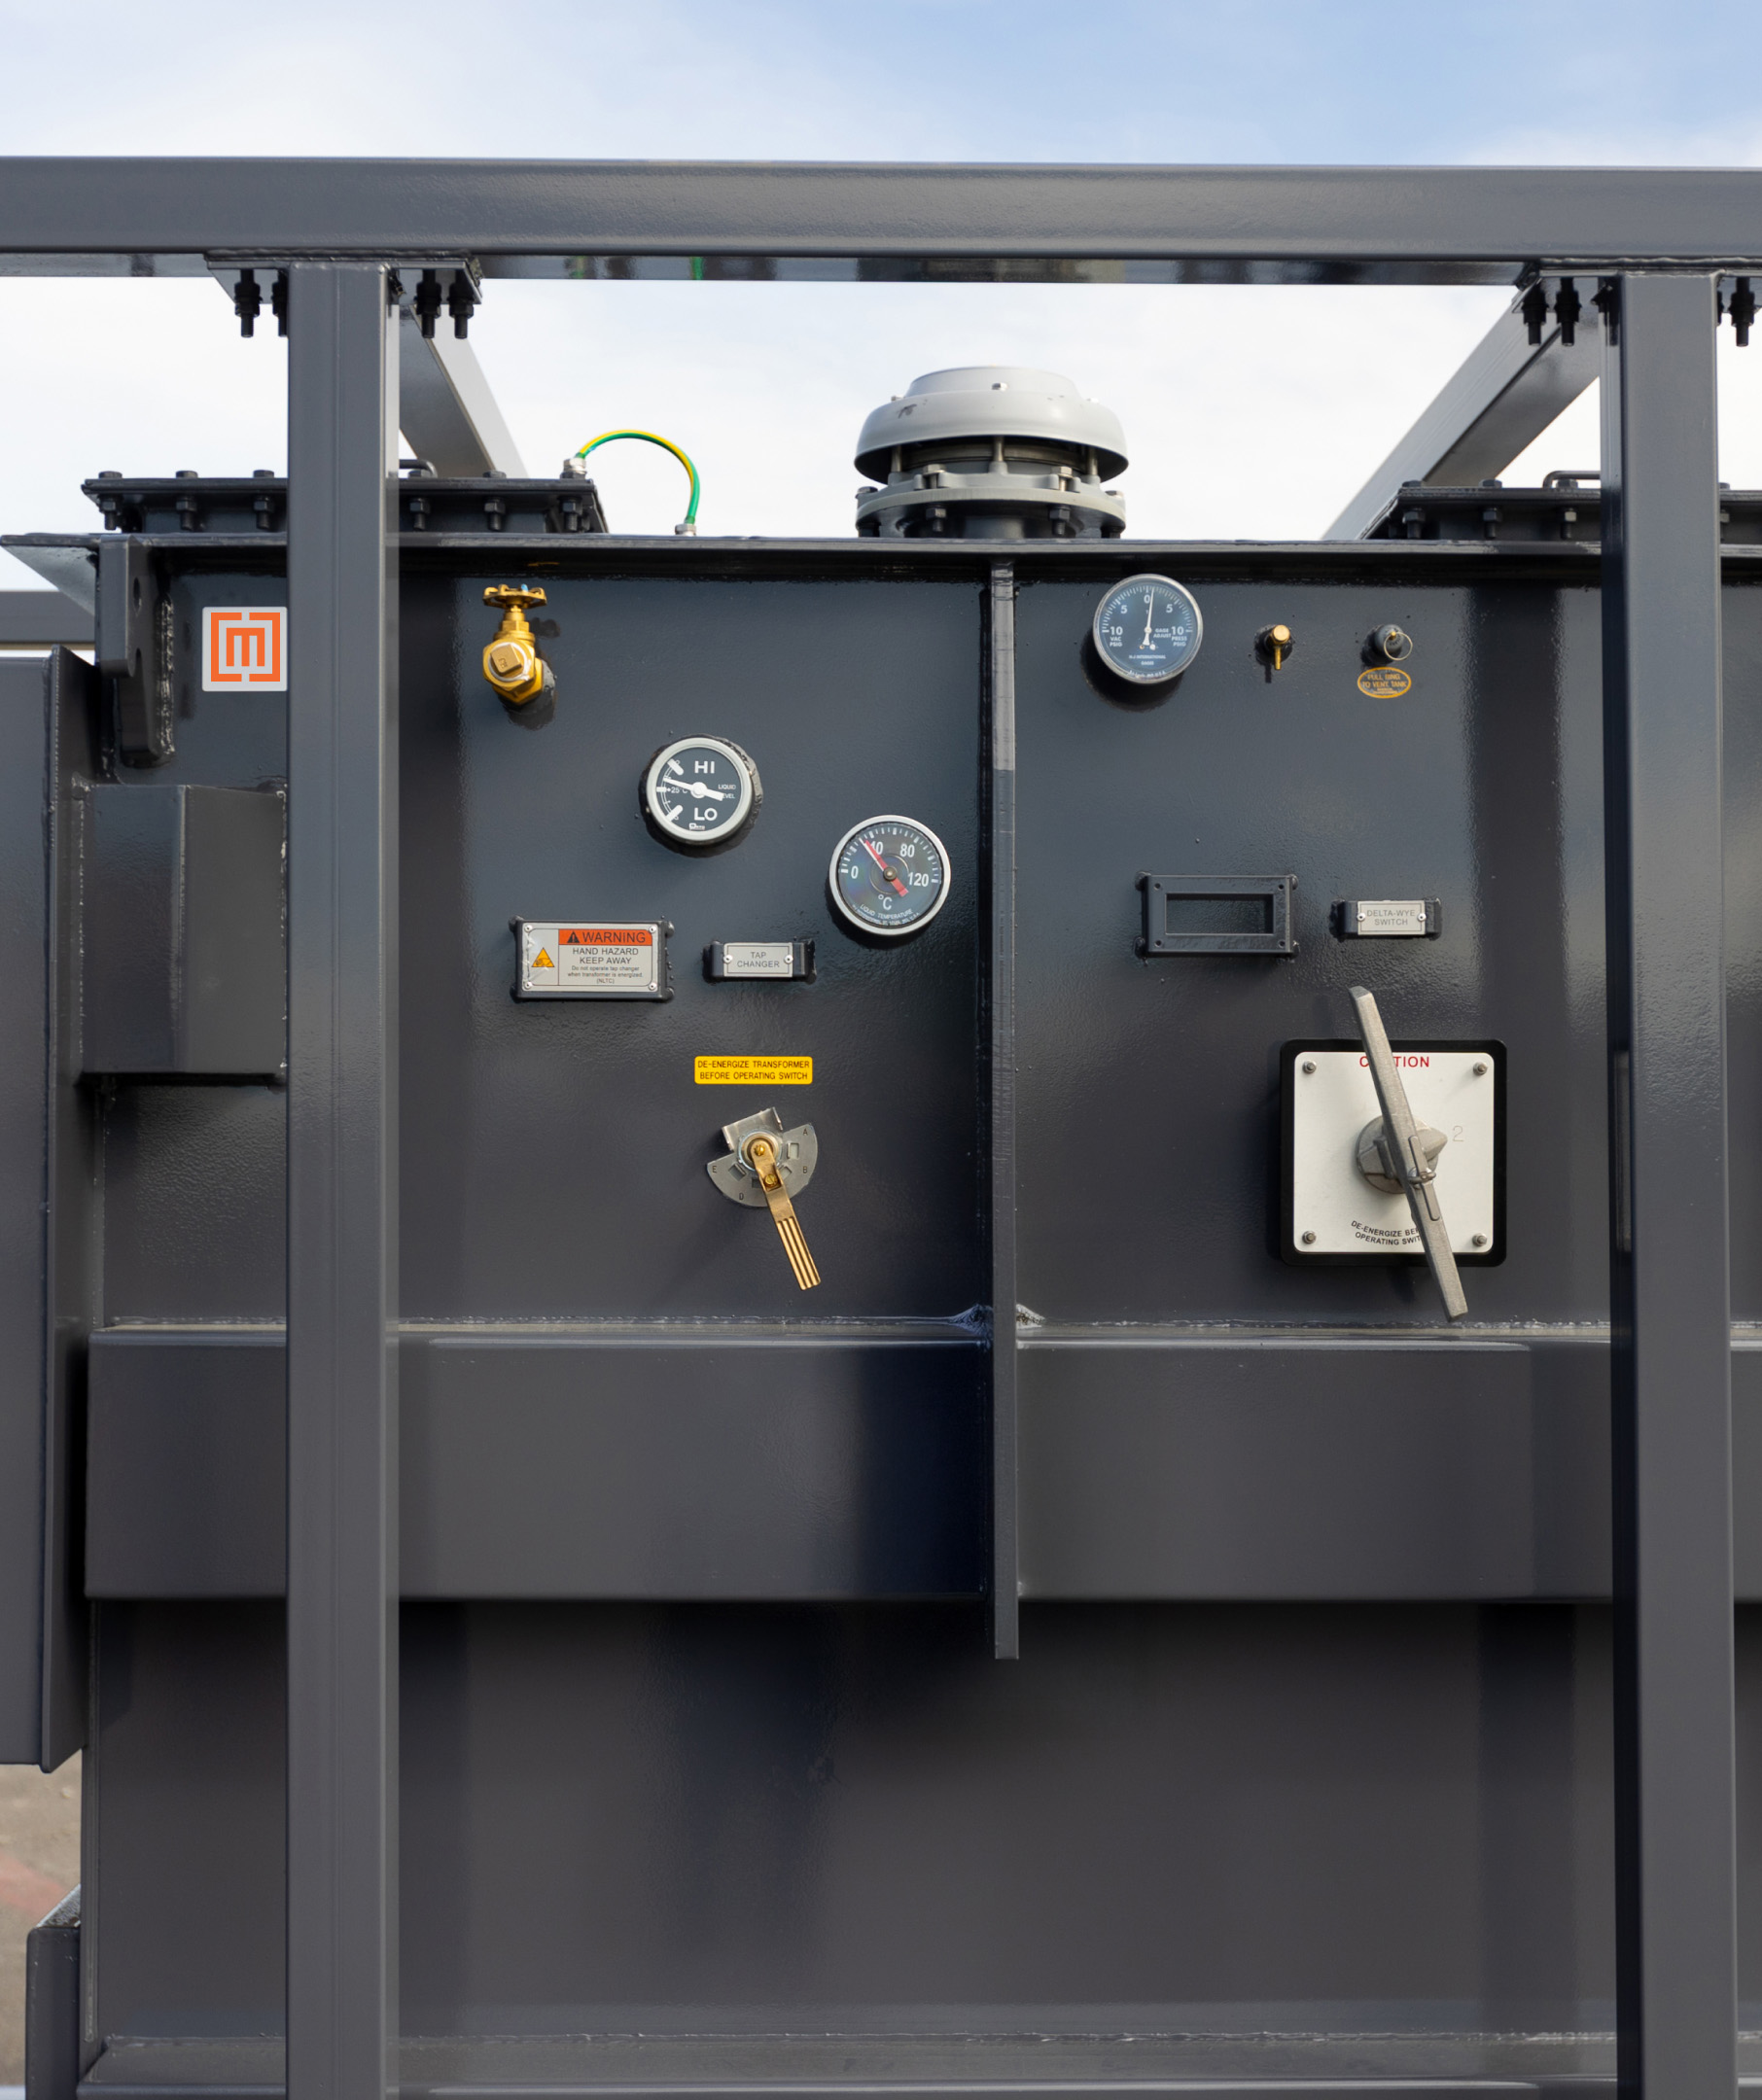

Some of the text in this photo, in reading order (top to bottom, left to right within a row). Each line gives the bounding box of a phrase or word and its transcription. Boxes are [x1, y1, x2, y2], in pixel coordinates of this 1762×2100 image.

[1144, 594, 1150, 604] 0
[1120, 605, 1128, 614] 5
[1166, 604, 1173, 613] 5
[1110, 626, 1123, 636] 10
[1172, 626, 1184, 636] 10
[694, 760, 715, 774] HI
[693, 807, 718, 822] LO
[899, 843, 915, 858] 80
[850, 865, 859, 879] 0
[907, 872, 930, 887] 120
[877, 893, 893, 911] °C
[860, 903, 876, 917] LIQUID
[877, 907, 914, 920] TEMPERATURE
[582, 931, 646, 943] WARNING
[573, 947, 639, 956] HAND HAZARD
[736, 960, 780, 968] CHANGER
[697, 1060, 810, 1068] DE-ENERGIZE TRANSFORMER
[1359, 1056, 1429, 1068] CTION
[1452, 1125, 1464, 1142] 2
[712, 1165, 718, 1173] E
[739, 1192, 744, 1201] D
[1351, 1220, 1402, 1238] DE-ENERGIZE
[1355, 1231, 1421, 1245] OPERATING SWIT
